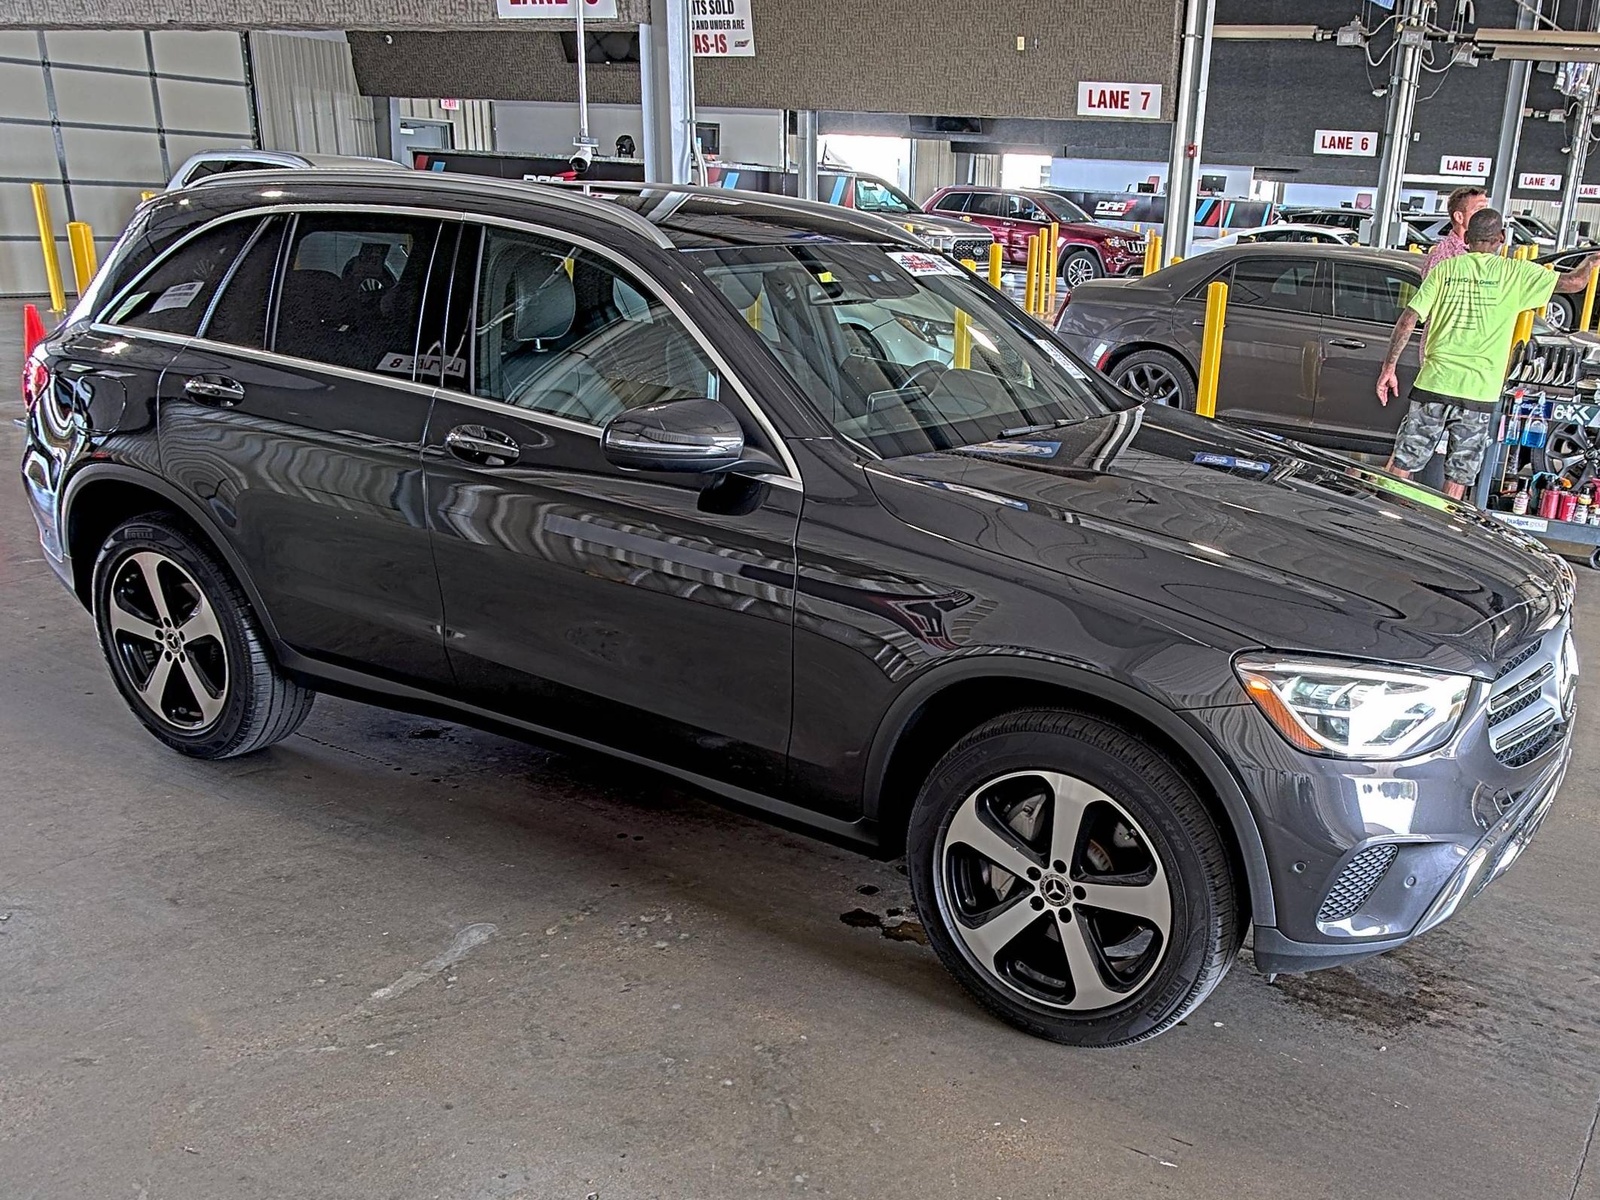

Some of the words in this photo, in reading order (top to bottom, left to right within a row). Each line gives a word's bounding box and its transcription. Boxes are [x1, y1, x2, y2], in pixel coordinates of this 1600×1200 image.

[691, 0, 707, 15] ITS
[709, 0, 735, 15] SOLD
[696, 19, 709, 30] AND
[710, 19, 732, 30] UNDER
[732, 19, 746, 30] ARE
[694, 33, 728, 54] AS-IS
[1087, 89, 1130, 109] LANE
[1140, 91, 1151, 110] 7
[1321, 135, 1354, 150] LANE
[1360, 137, 1370, 151] 6
[1446, 159, 1473, 171] LANE
[1477, 161, 1485, 172] 5
[1523, 176, 1546, 187] LANE
[1549, 178, 1556, 187] 4
[1579, 187, 1598, 195] LANE
